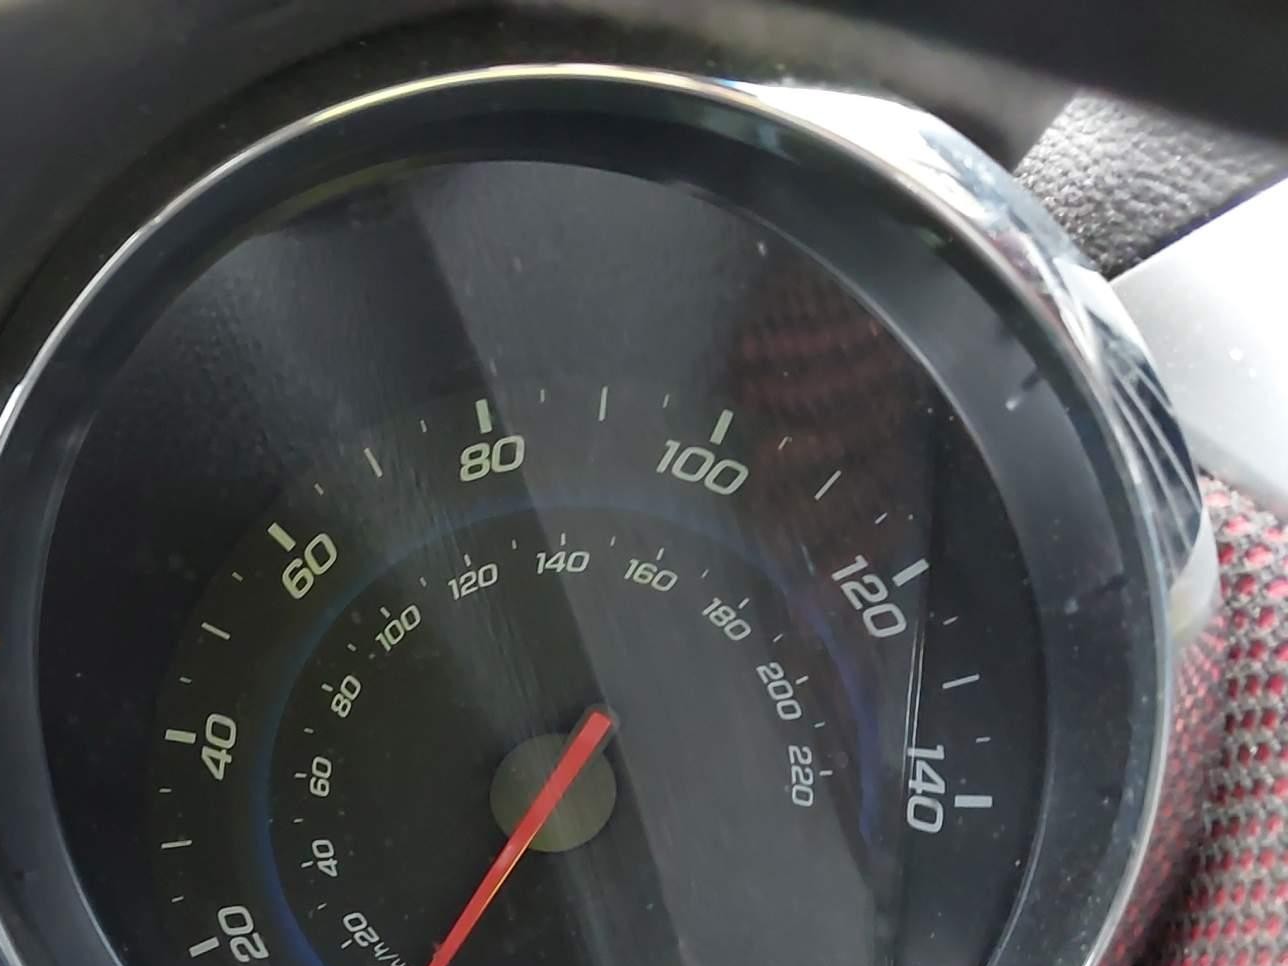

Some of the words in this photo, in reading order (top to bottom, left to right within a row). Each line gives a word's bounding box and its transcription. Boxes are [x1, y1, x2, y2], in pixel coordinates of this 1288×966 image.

[459, 434, 526, 482] 80
[656, 439, 750, 495] 100
[281, 533, 338, 600] 60
[448, 563, 499, 601] 120
[535, 551, 590, 574] 140
[623, 558, 679, 592] 160
[701, 597, 752, 641] 180
[831, 554, 908, 638] 120
[375, 605, 422, 653] 100
[330, 674, 362, 719] 80
[756, 661, 802, 721] 200
[200, 712, 238, 781] 40
[309, 756, 333, 798] 60
[788, 744, 814, 807] 220
[905, 744, 945, 834] 140
[311, 838, 339, 877] 40
[217, 905, 270, 963] 20
[343, 911, 380, 948] 20
